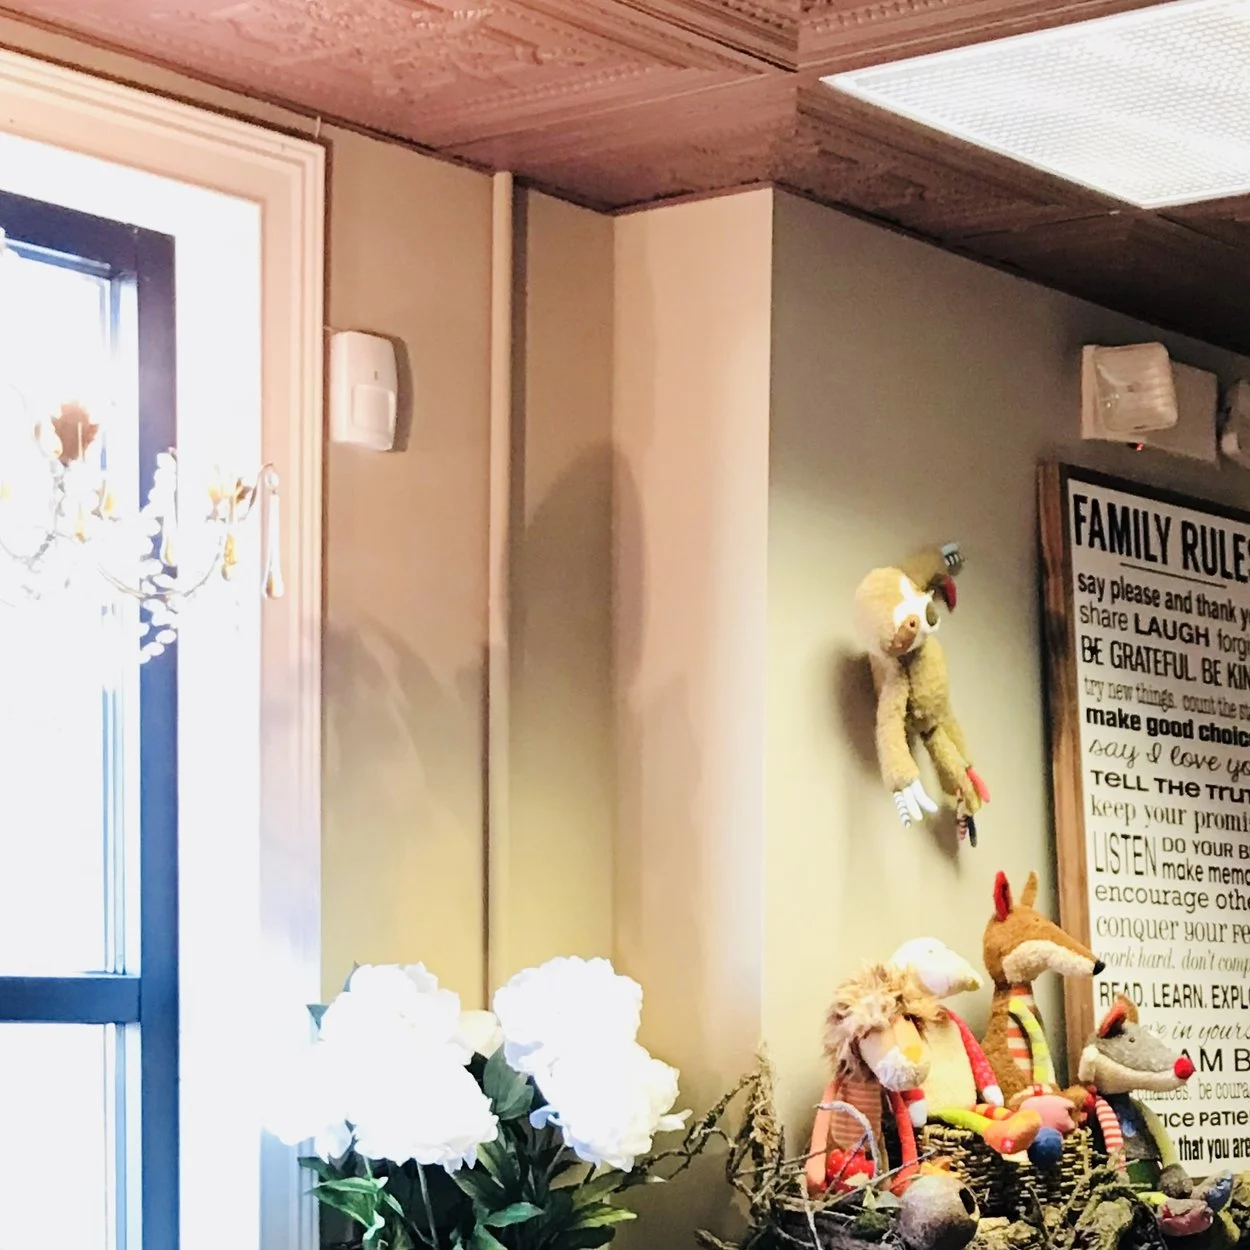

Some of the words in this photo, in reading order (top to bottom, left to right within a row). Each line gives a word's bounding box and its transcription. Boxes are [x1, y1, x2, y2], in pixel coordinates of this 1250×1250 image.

[1073, 494, 1171, 565] FAMILY
[1078, 573, 1105, 602] say
[1111, 576, 1160, 608] please
[1165, 591, 1192, 614] and
[1196, 594, 1236, 623] thank
[1080, 602, 1128, 631] share
[1135, 613, 1210, 647] LAUGH
[1081, 635, 1104, 666] BE
[1110, 640, 1197, 682] GRATEFUL.
[1202, 657, 1222, 686] BE
[1084, 676, 1104, 702] try
[1108, 681, 1133, 701] new
[1182, 694, 1216, 715] count
[1217, 696, 1236, 719] the
[1086, 707, 1141, 731] make
[1147, 717, 1194, 739] good
[1089, 739, 1139, 769] say
[1146, 742, 1162, 764] I
[1170, 745, 1221, 772] love
[1090, 795, 1136, 826] keep
[1144, 804, 1187, 828] your
[1094, 831, 1158, 877] LISTEN
[1162, 836, 1186, 854] DO
[1192, 840, 1234, 859] YOUR
[1162, 858, 1203, 882] make
[1095, 884, 1209, 914] encourage
[1184, 920, 1228, 942] your
[1138, 946, 1176, 969] hard.
[1181, 949, 1216, 970] don't
[1152, 982, 1208, 1008] LEARN.
[1172, 1020, 1192, 1040] in
[1198, 1078, 1212, 1100] be
[1179, 1134, 1204, 1161] that
[1207, 1138, 1230, 1163] you
